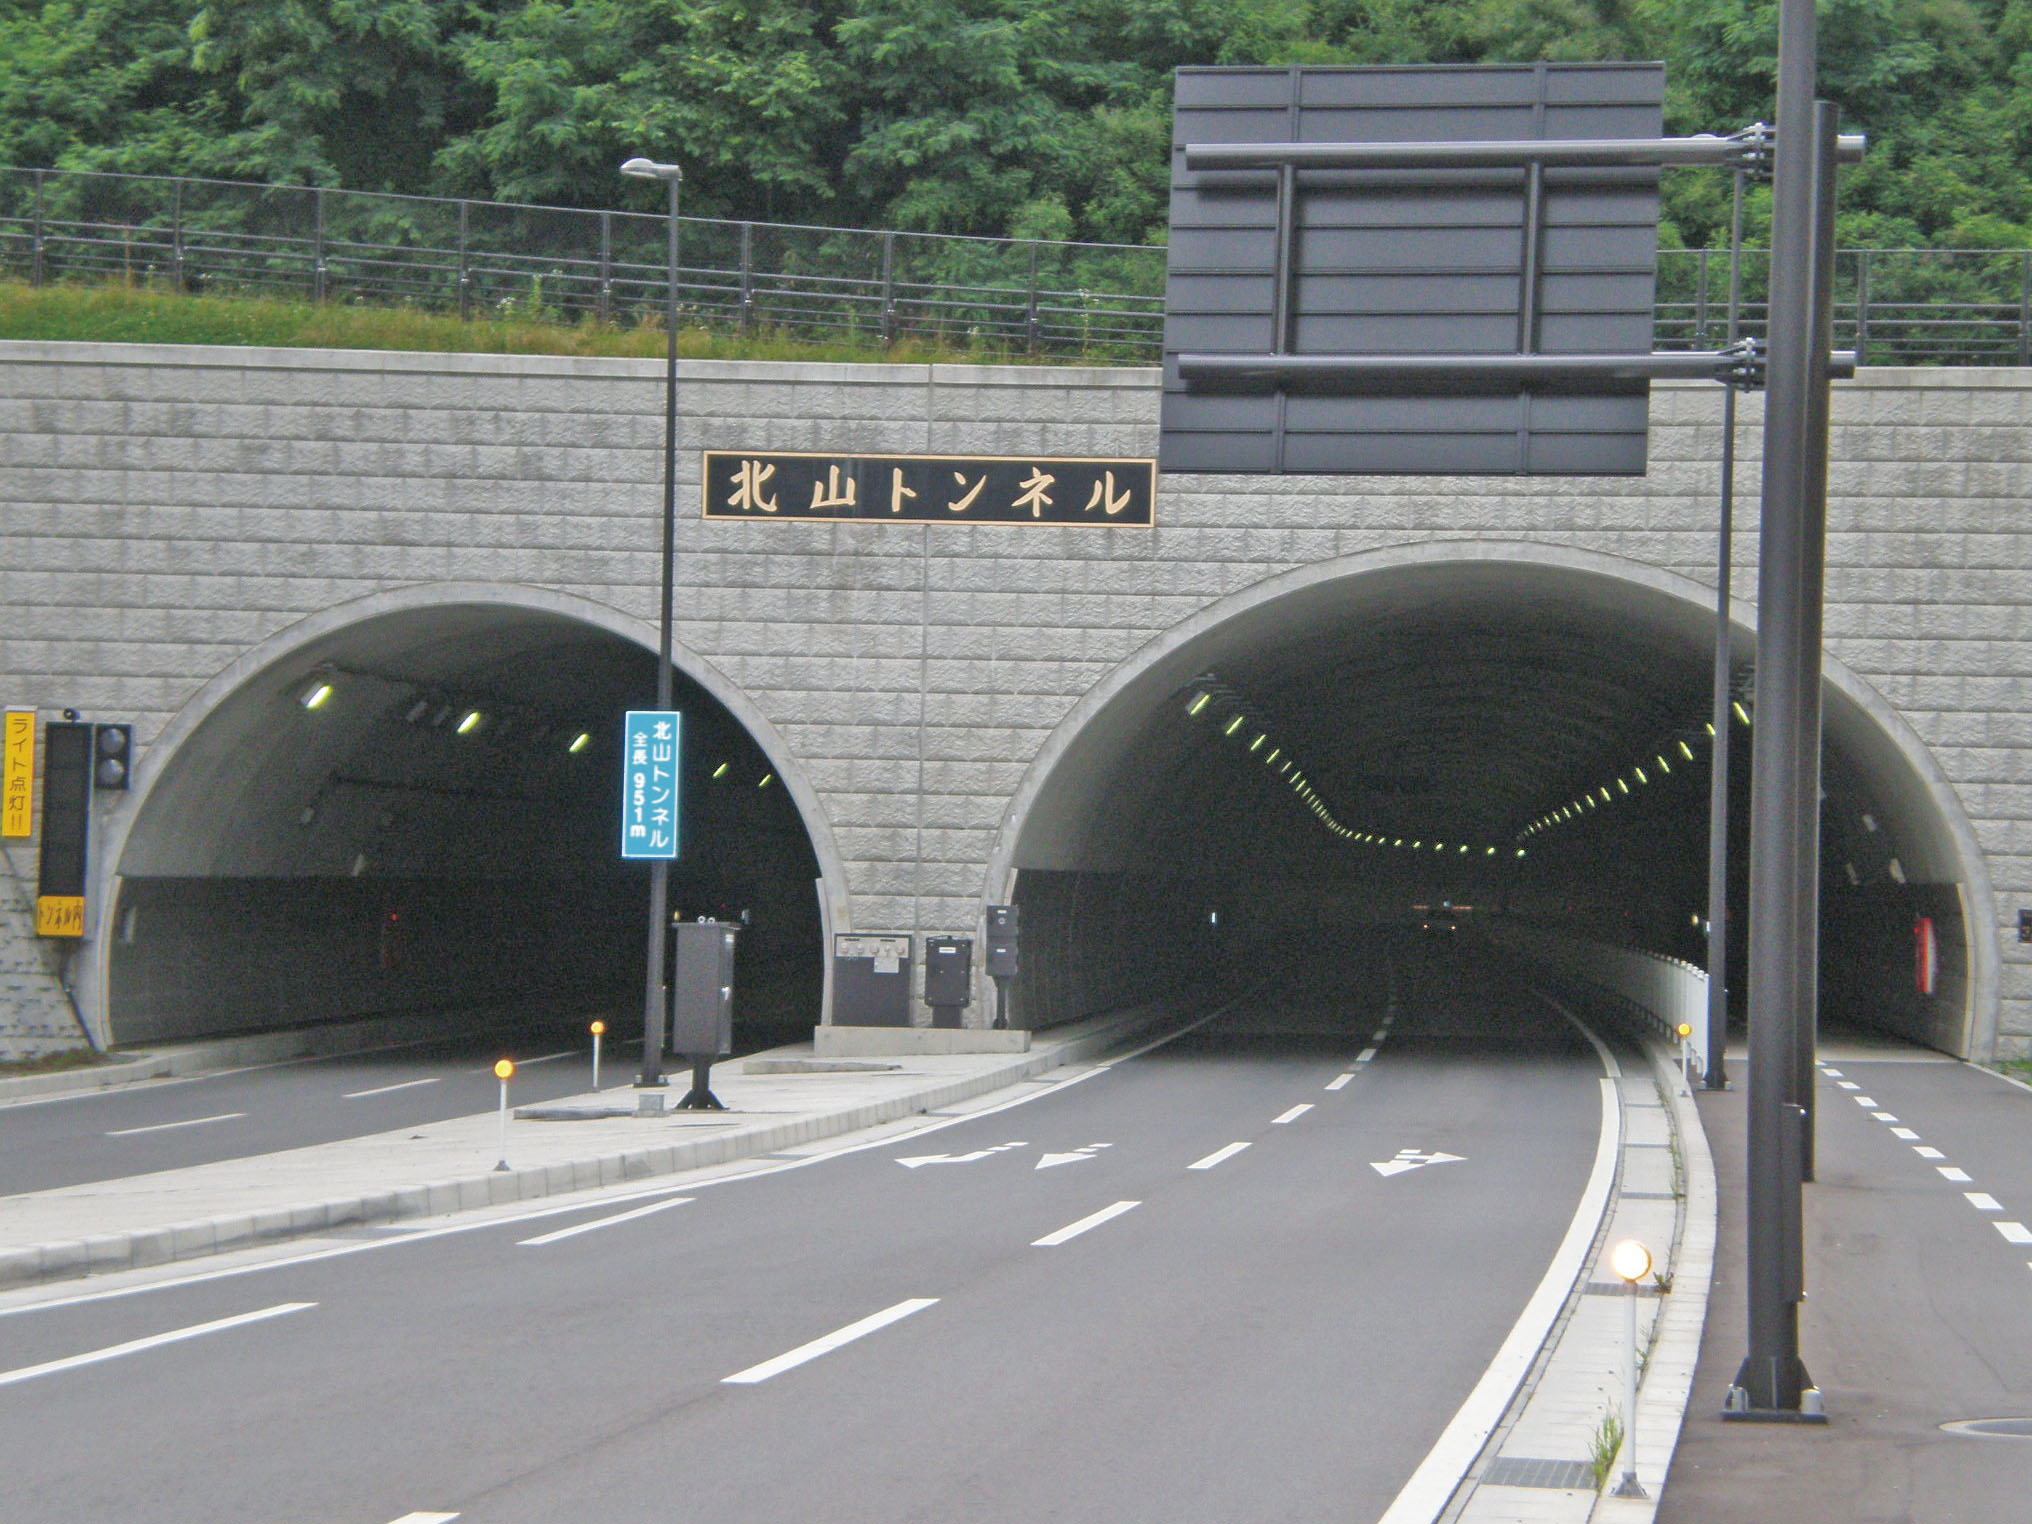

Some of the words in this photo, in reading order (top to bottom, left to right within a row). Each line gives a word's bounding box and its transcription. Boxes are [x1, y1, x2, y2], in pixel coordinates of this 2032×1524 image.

[727, 460, 1131, 518] 北山トンネル
[649, 720, 672, 848] 北山トンネル
